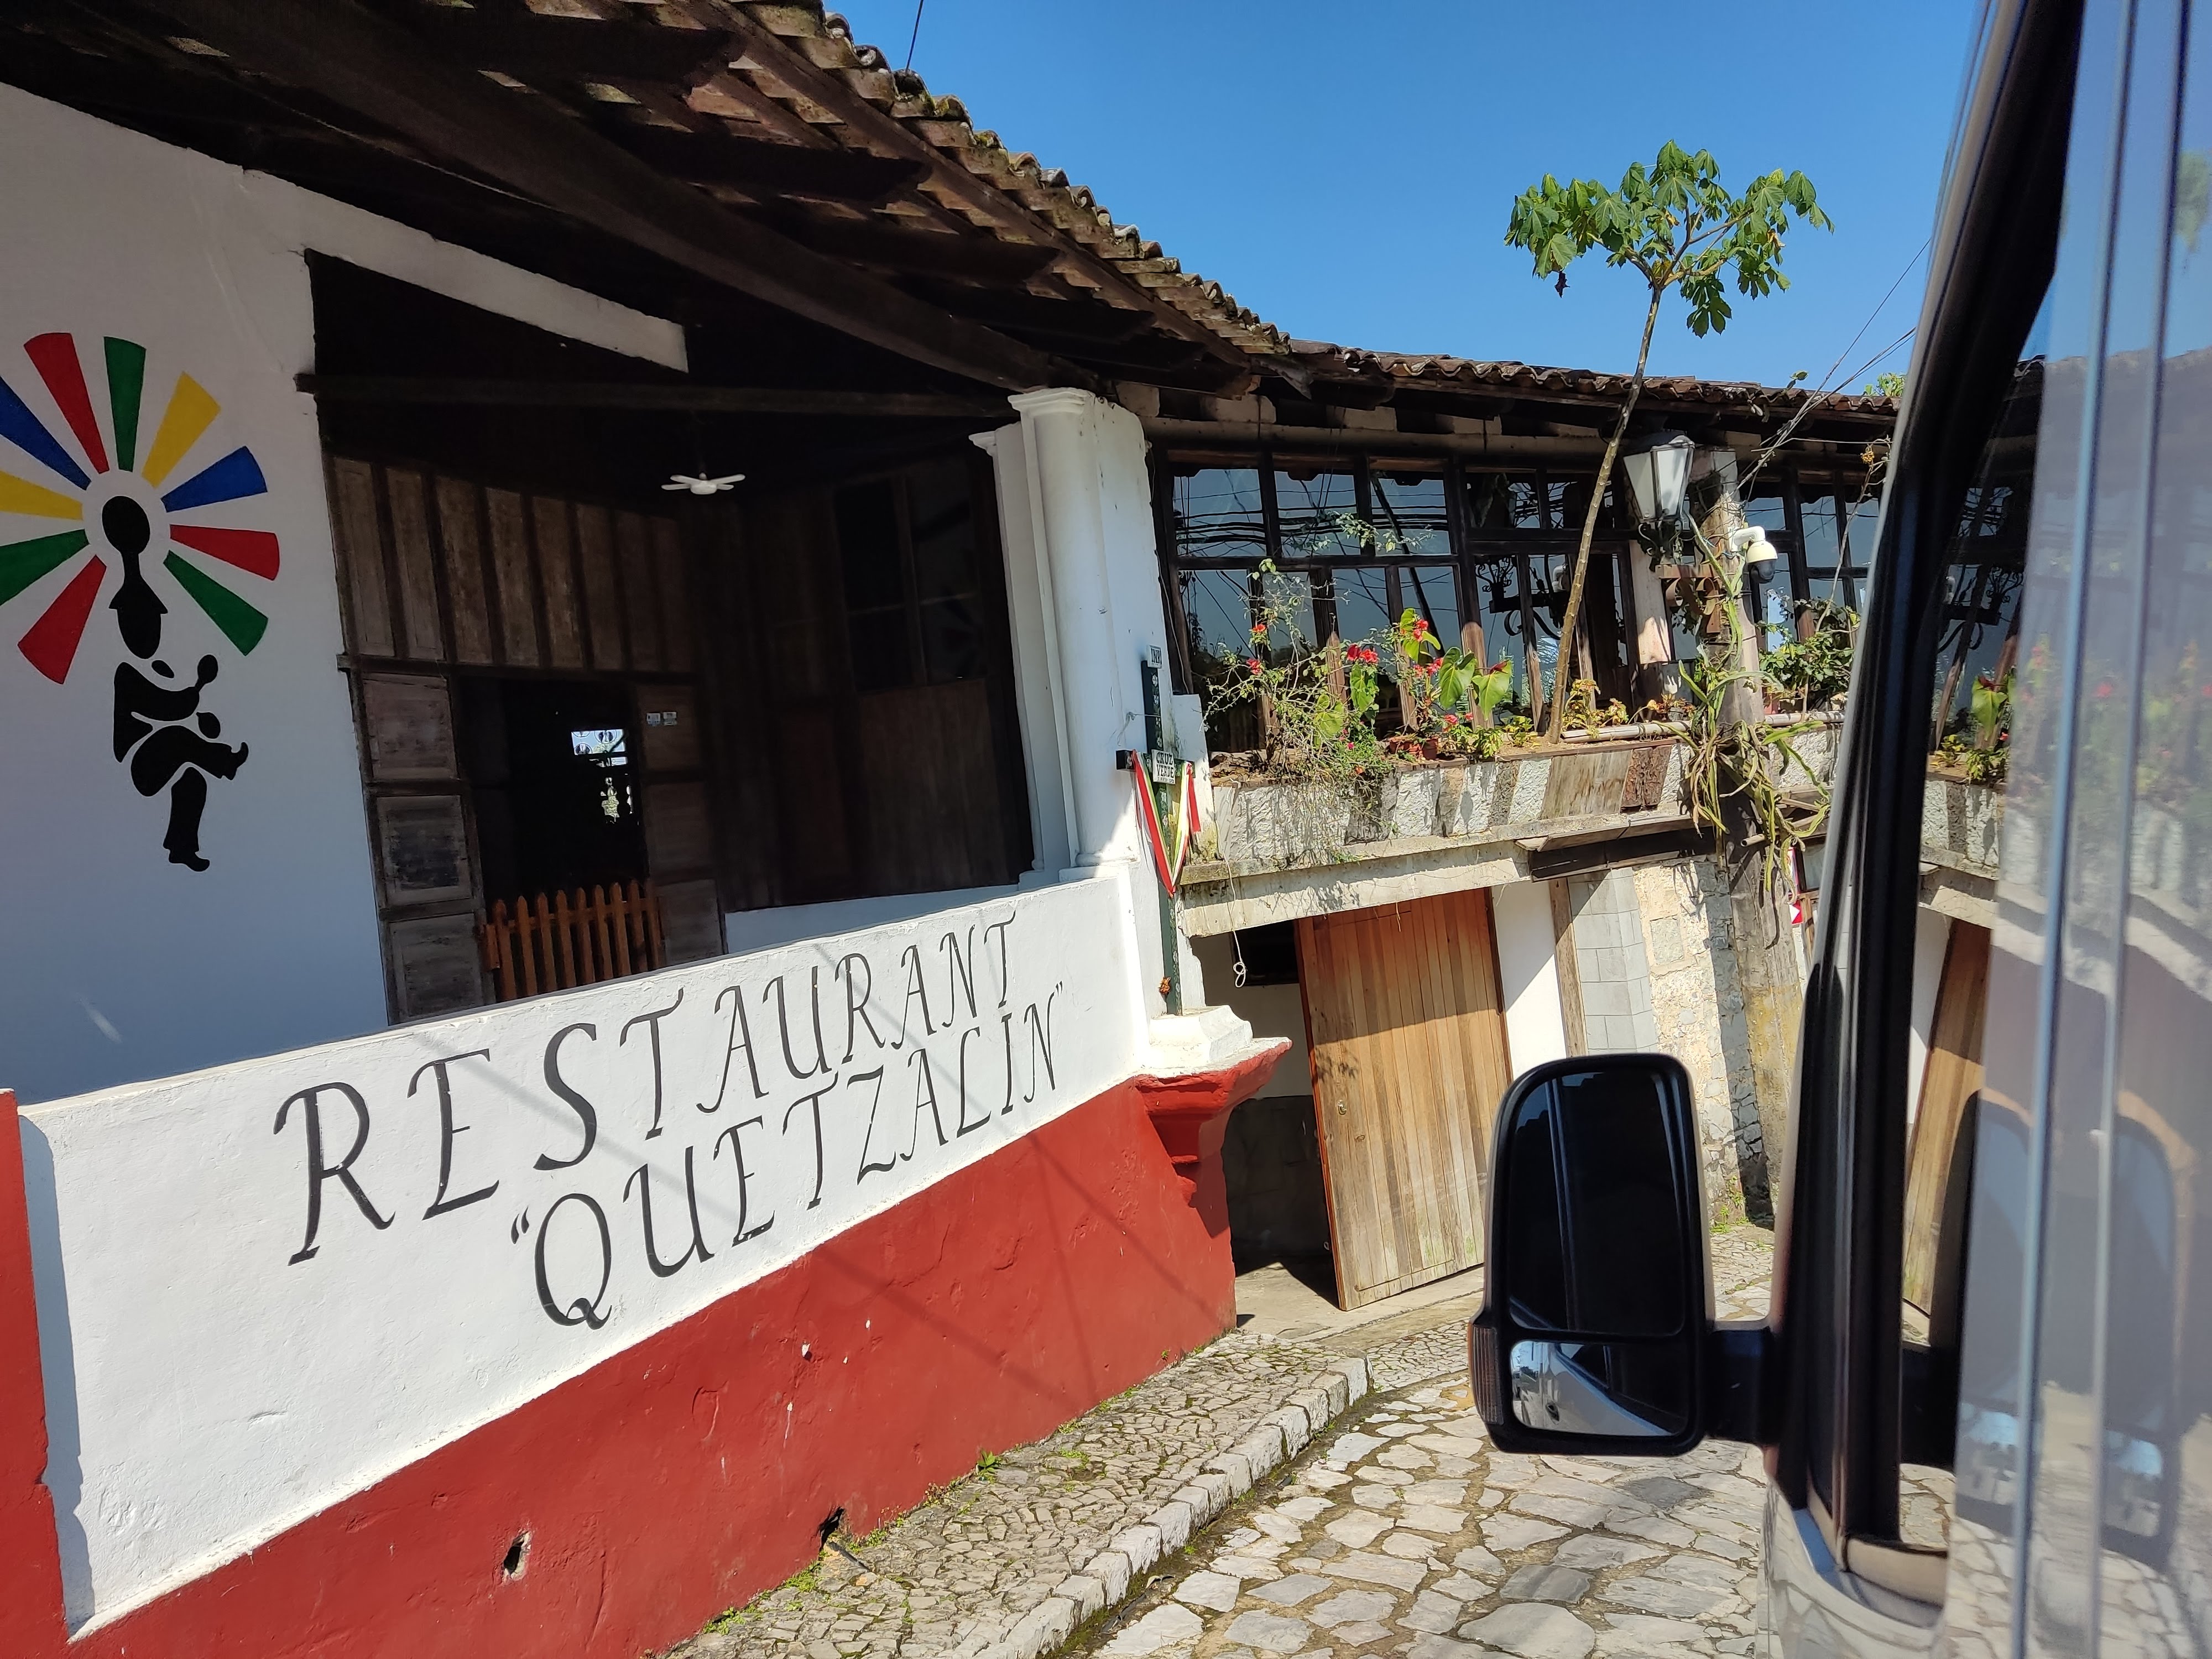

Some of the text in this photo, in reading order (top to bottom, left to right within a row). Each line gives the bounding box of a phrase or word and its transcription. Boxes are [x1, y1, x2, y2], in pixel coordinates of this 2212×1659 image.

[1156, 752, 1172, 765] CRUZ
[1157, 764, 1173, 778] VERDE
[273, 909, 1016, 1266] RESTAURANT
